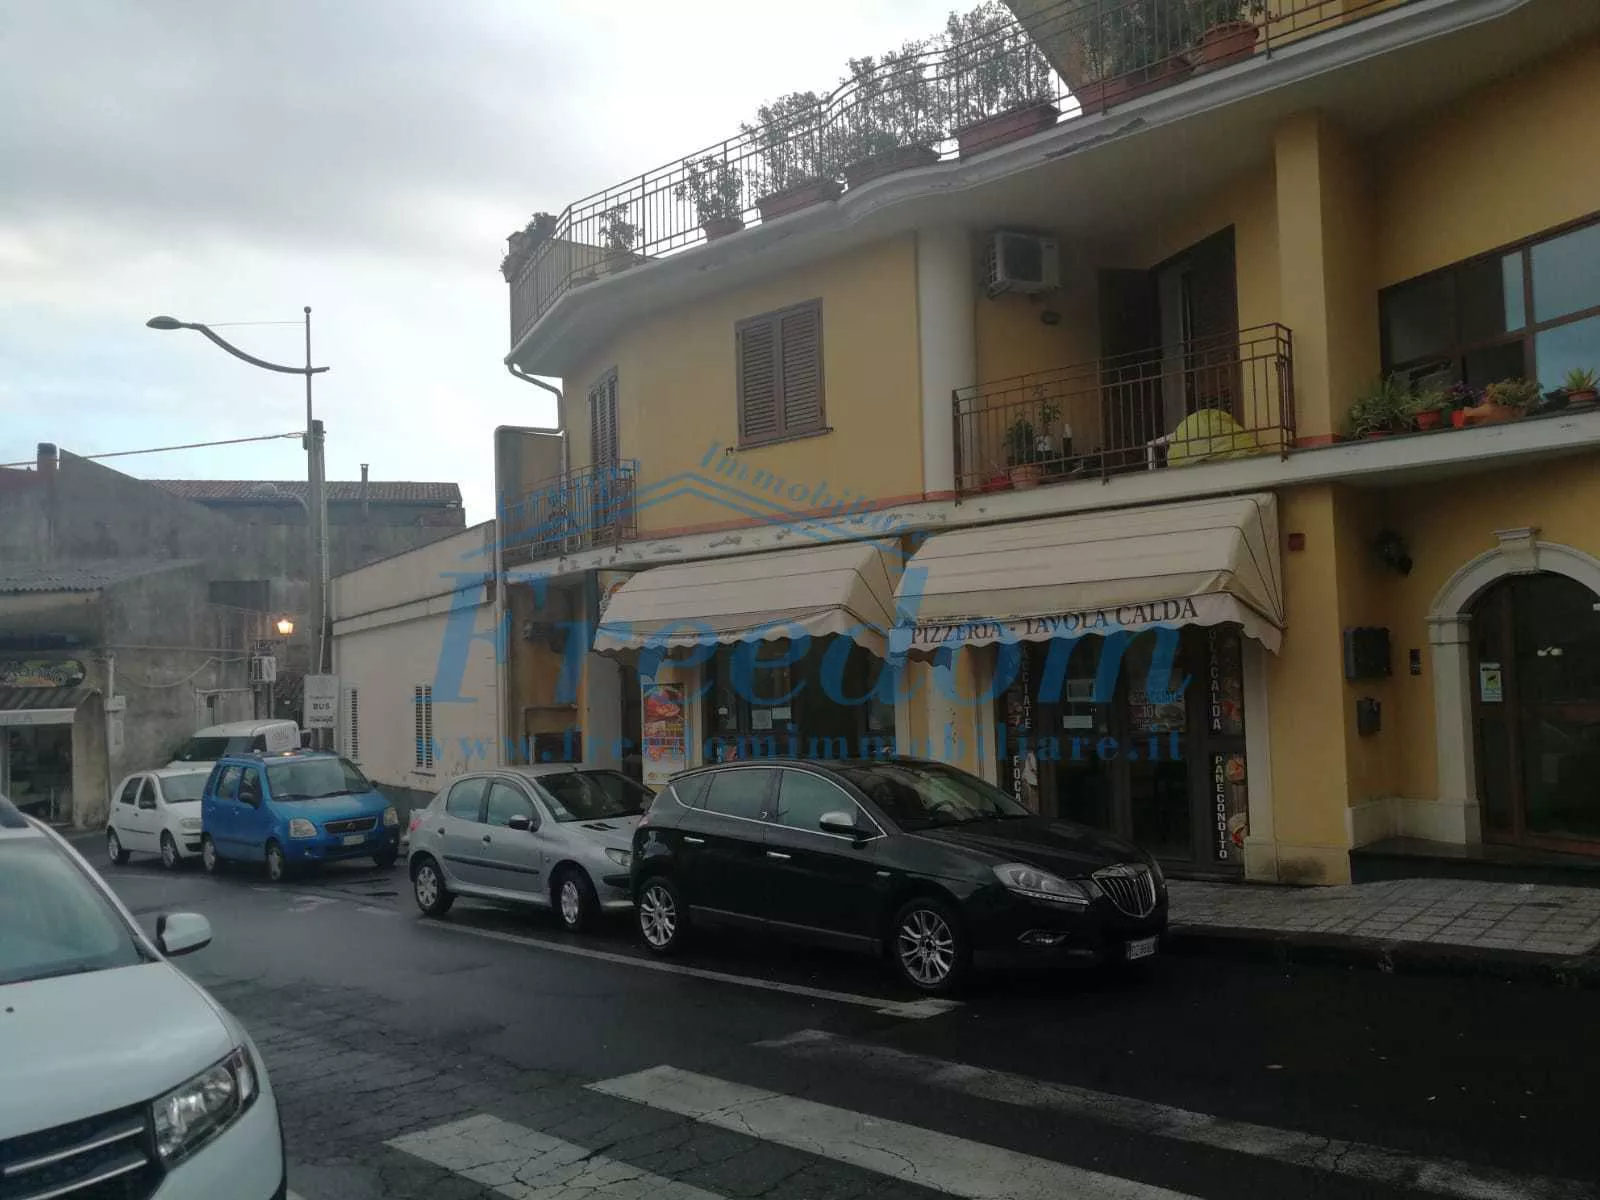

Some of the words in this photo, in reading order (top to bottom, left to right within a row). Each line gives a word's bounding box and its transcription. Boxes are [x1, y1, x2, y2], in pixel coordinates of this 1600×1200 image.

[911, 620, 1003, 645] PIZZERIA
[1115, 598, 1199, 626] CALDA
[312, 702, 331, 711] BUS
[1013, 755, 1022, 802] FOCA
